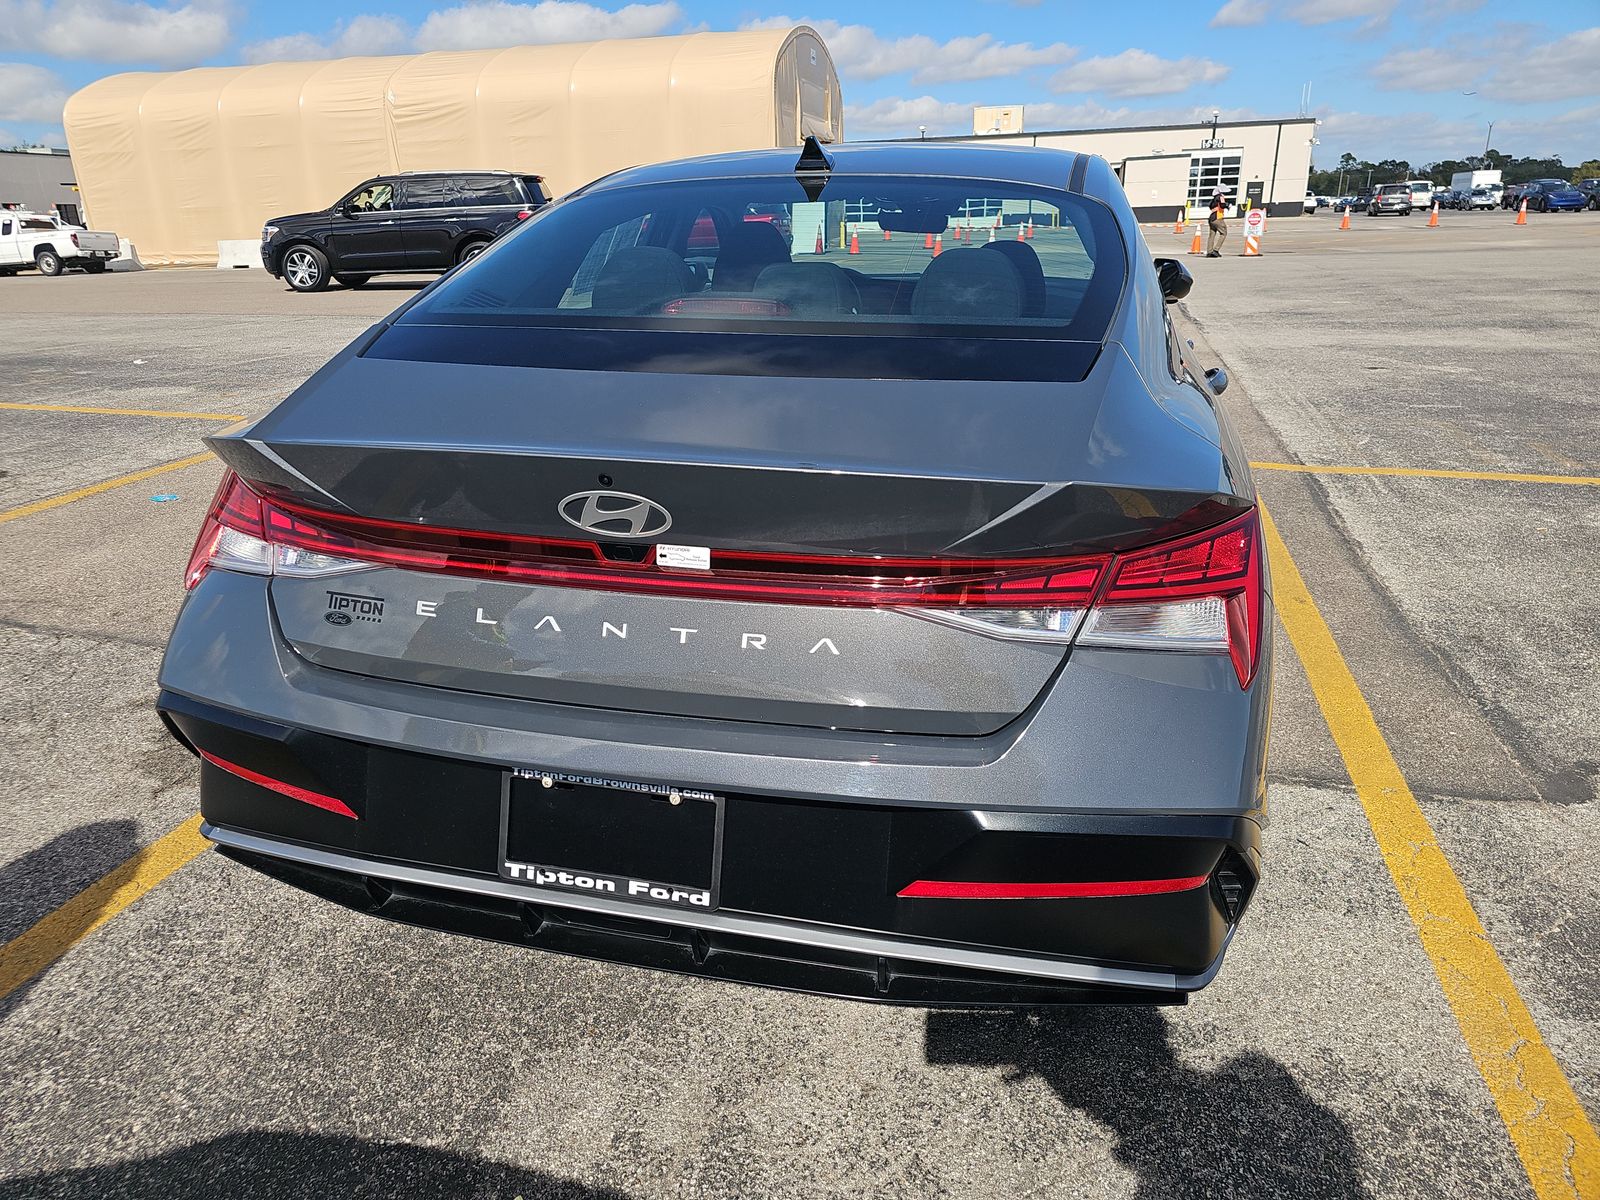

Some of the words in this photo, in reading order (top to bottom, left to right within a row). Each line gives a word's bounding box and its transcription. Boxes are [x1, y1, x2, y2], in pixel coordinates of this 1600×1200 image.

[326, 590, 385, 616] TIPTON
[416, 600, 840, 655] ELANTRA
[511, 766, 715, 800] TiptonFordBrownsville.com
[504, 862, 616, 892] Tipton
[628, 880, 711, 907] Ford
